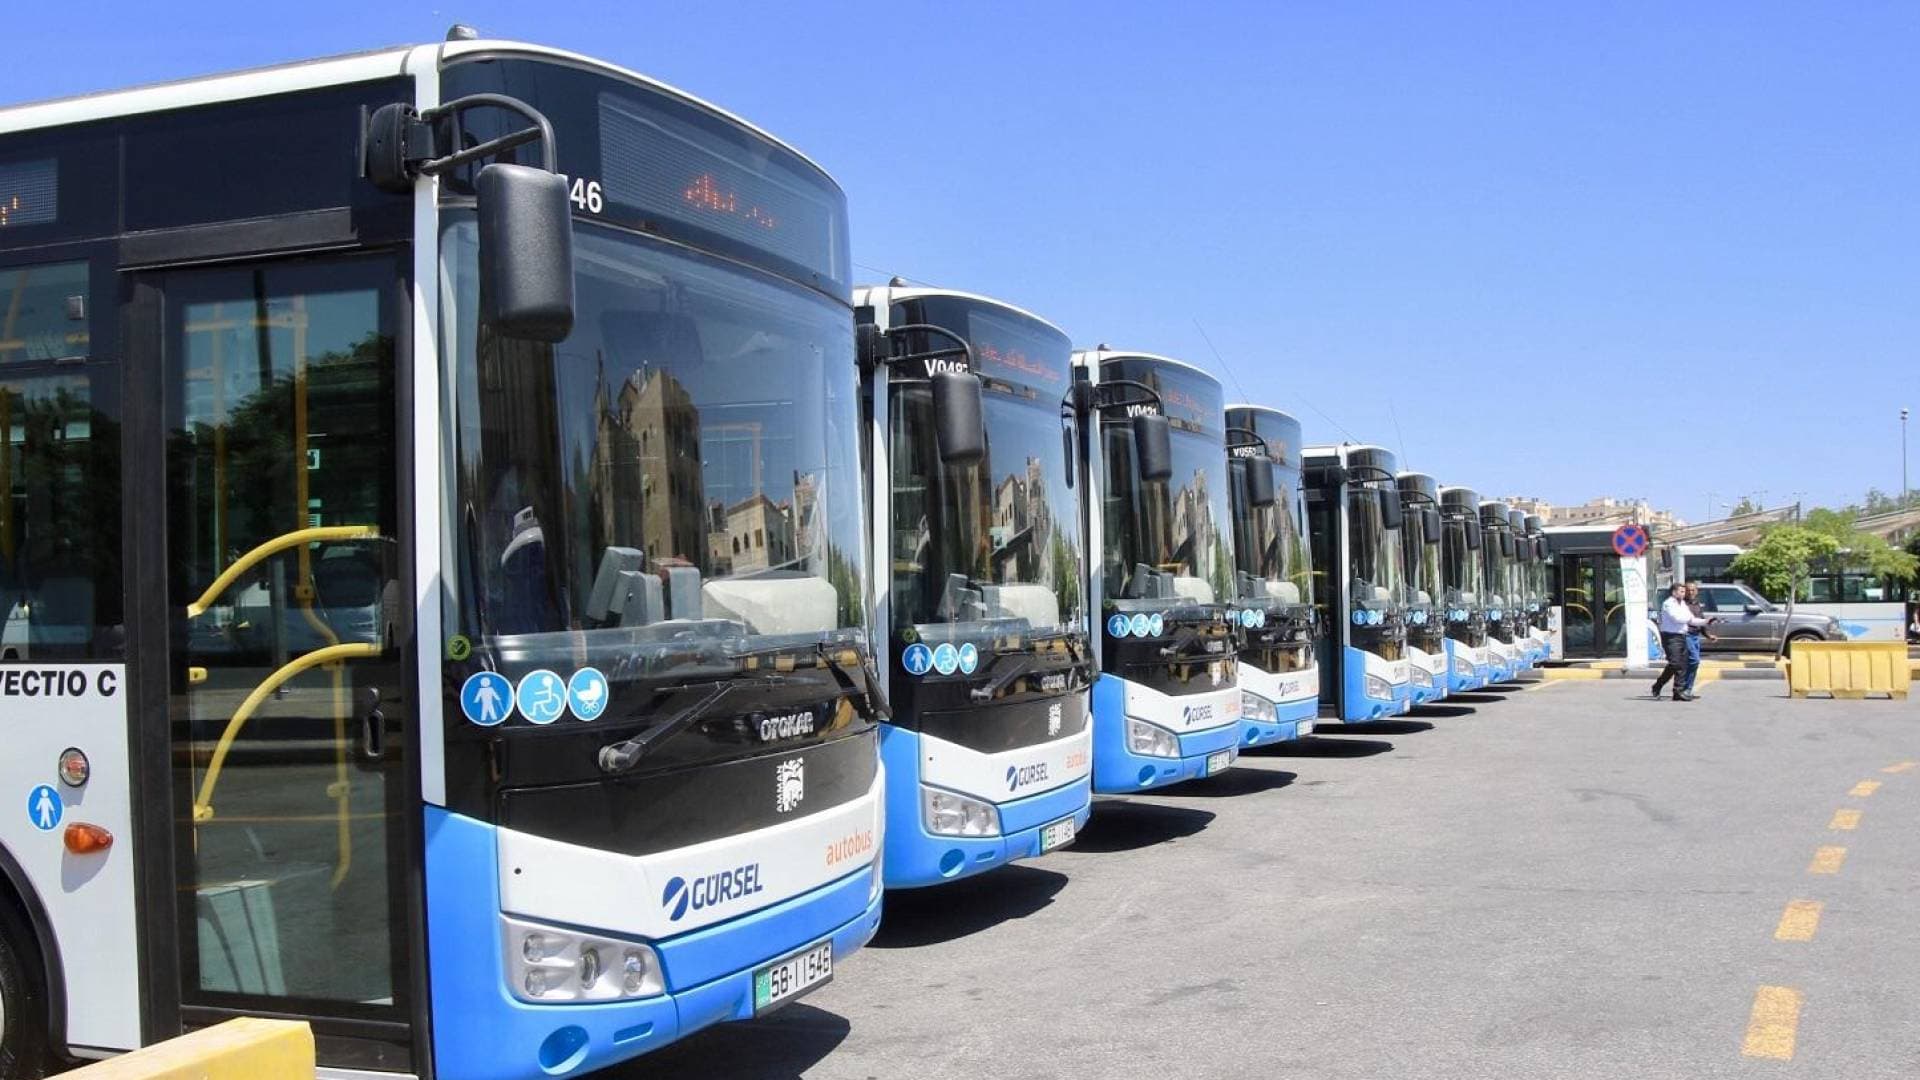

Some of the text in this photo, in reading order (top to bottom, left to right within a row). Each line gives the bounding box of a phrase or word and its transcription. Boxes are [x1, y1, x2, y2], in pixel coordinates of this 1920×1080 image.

[564, 174, 603, 213] 46
[0, 669, 117, 697] ECTIO C
[760, 711, 814, 741] OTOKAR
[826, 828, 873, 866] autobus
[691, 863, 763, 910] GÜRSEL
